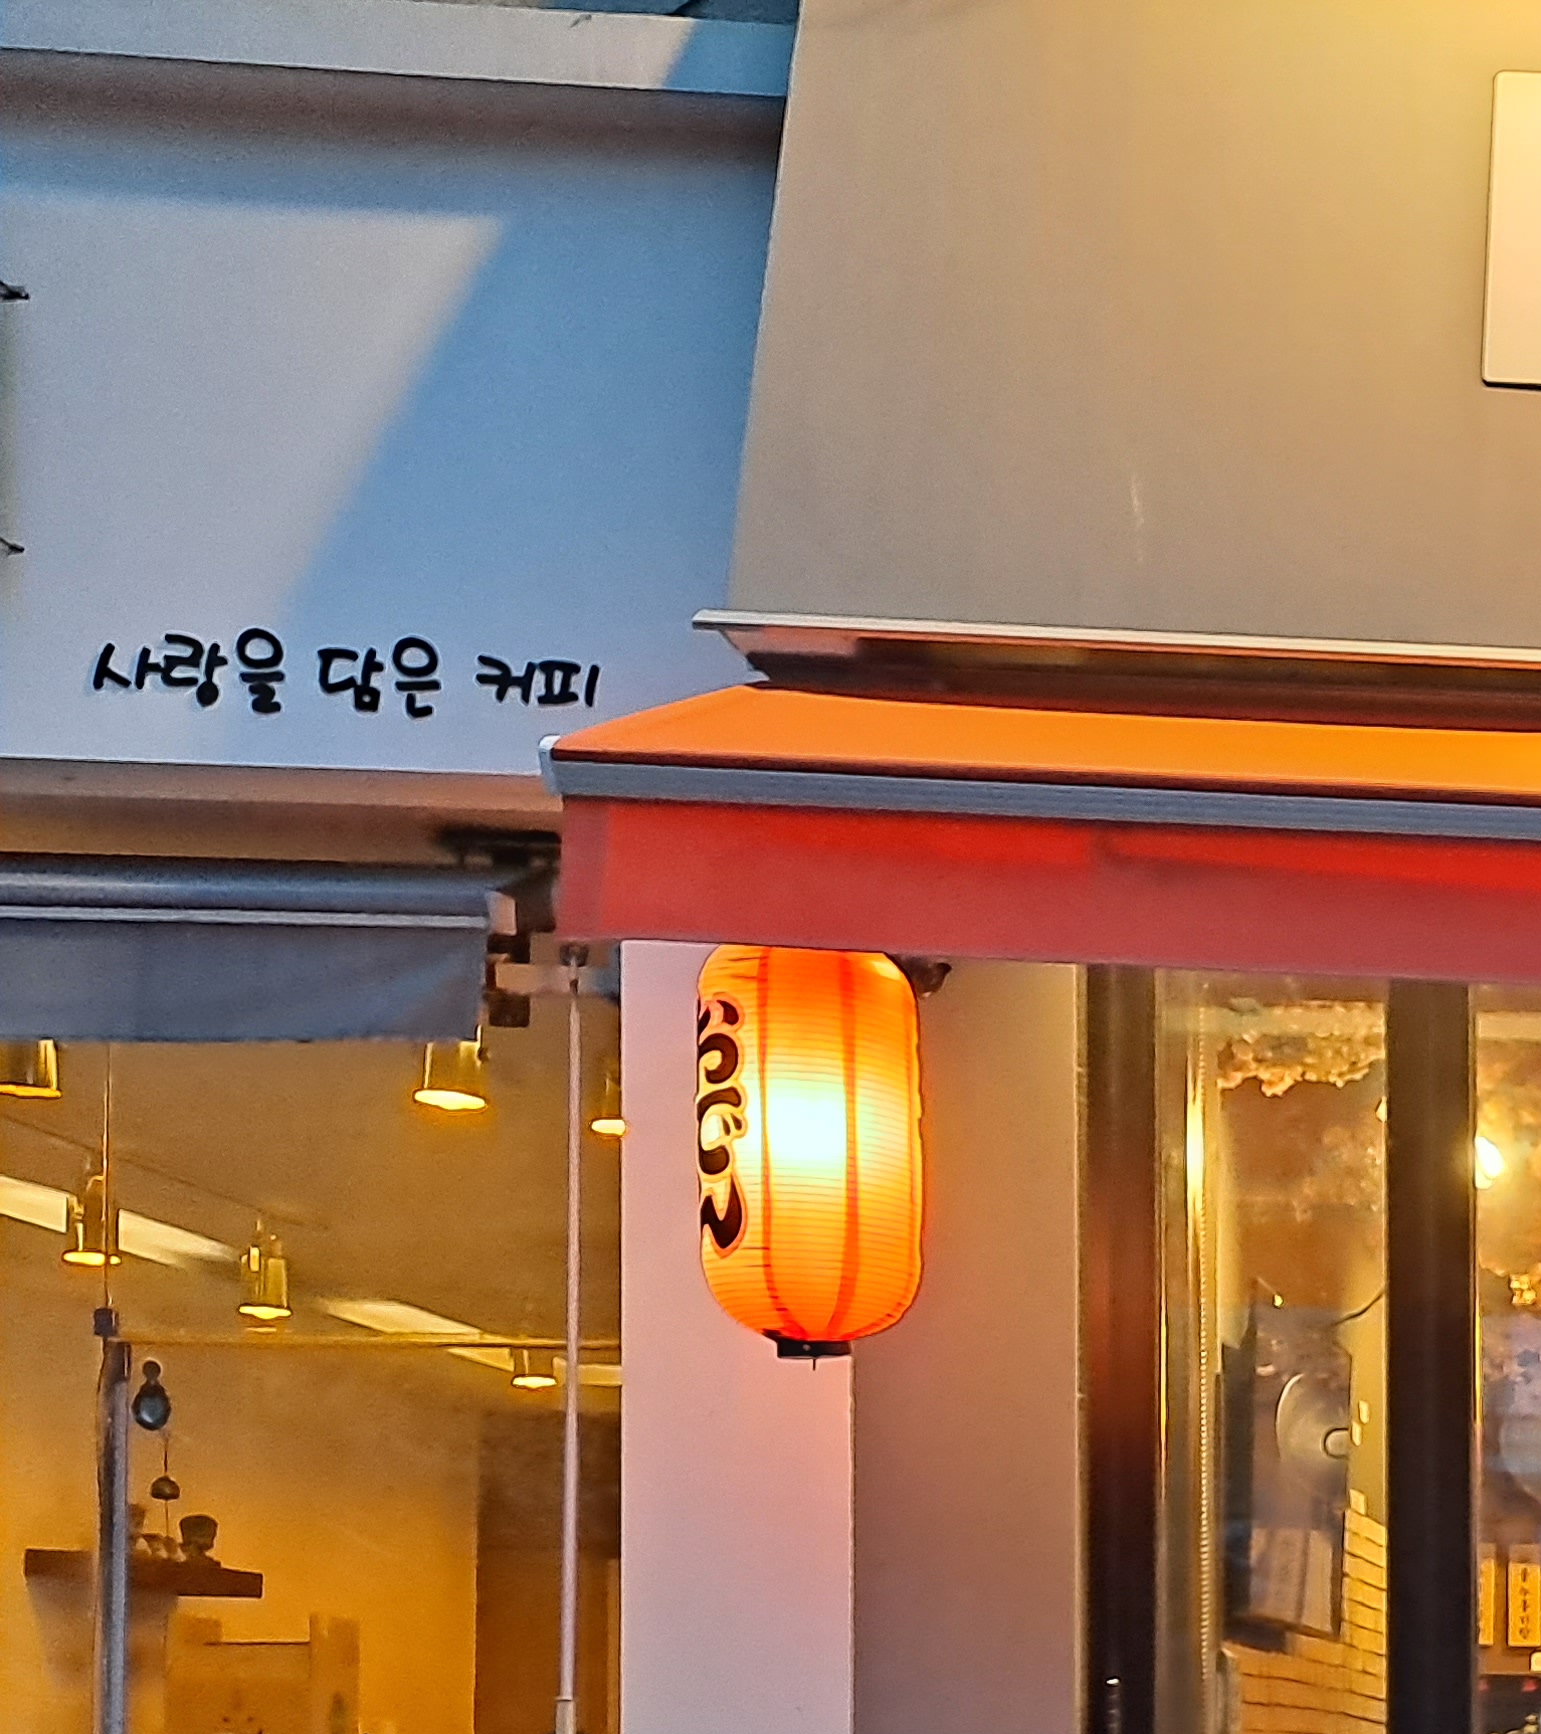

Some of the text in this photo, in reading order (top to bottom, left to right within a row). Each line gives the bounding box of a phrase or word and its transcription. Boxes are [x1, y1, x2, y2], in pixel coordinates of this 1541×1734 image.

[92, 627, 604, 719] 사랑을 담은 커피
